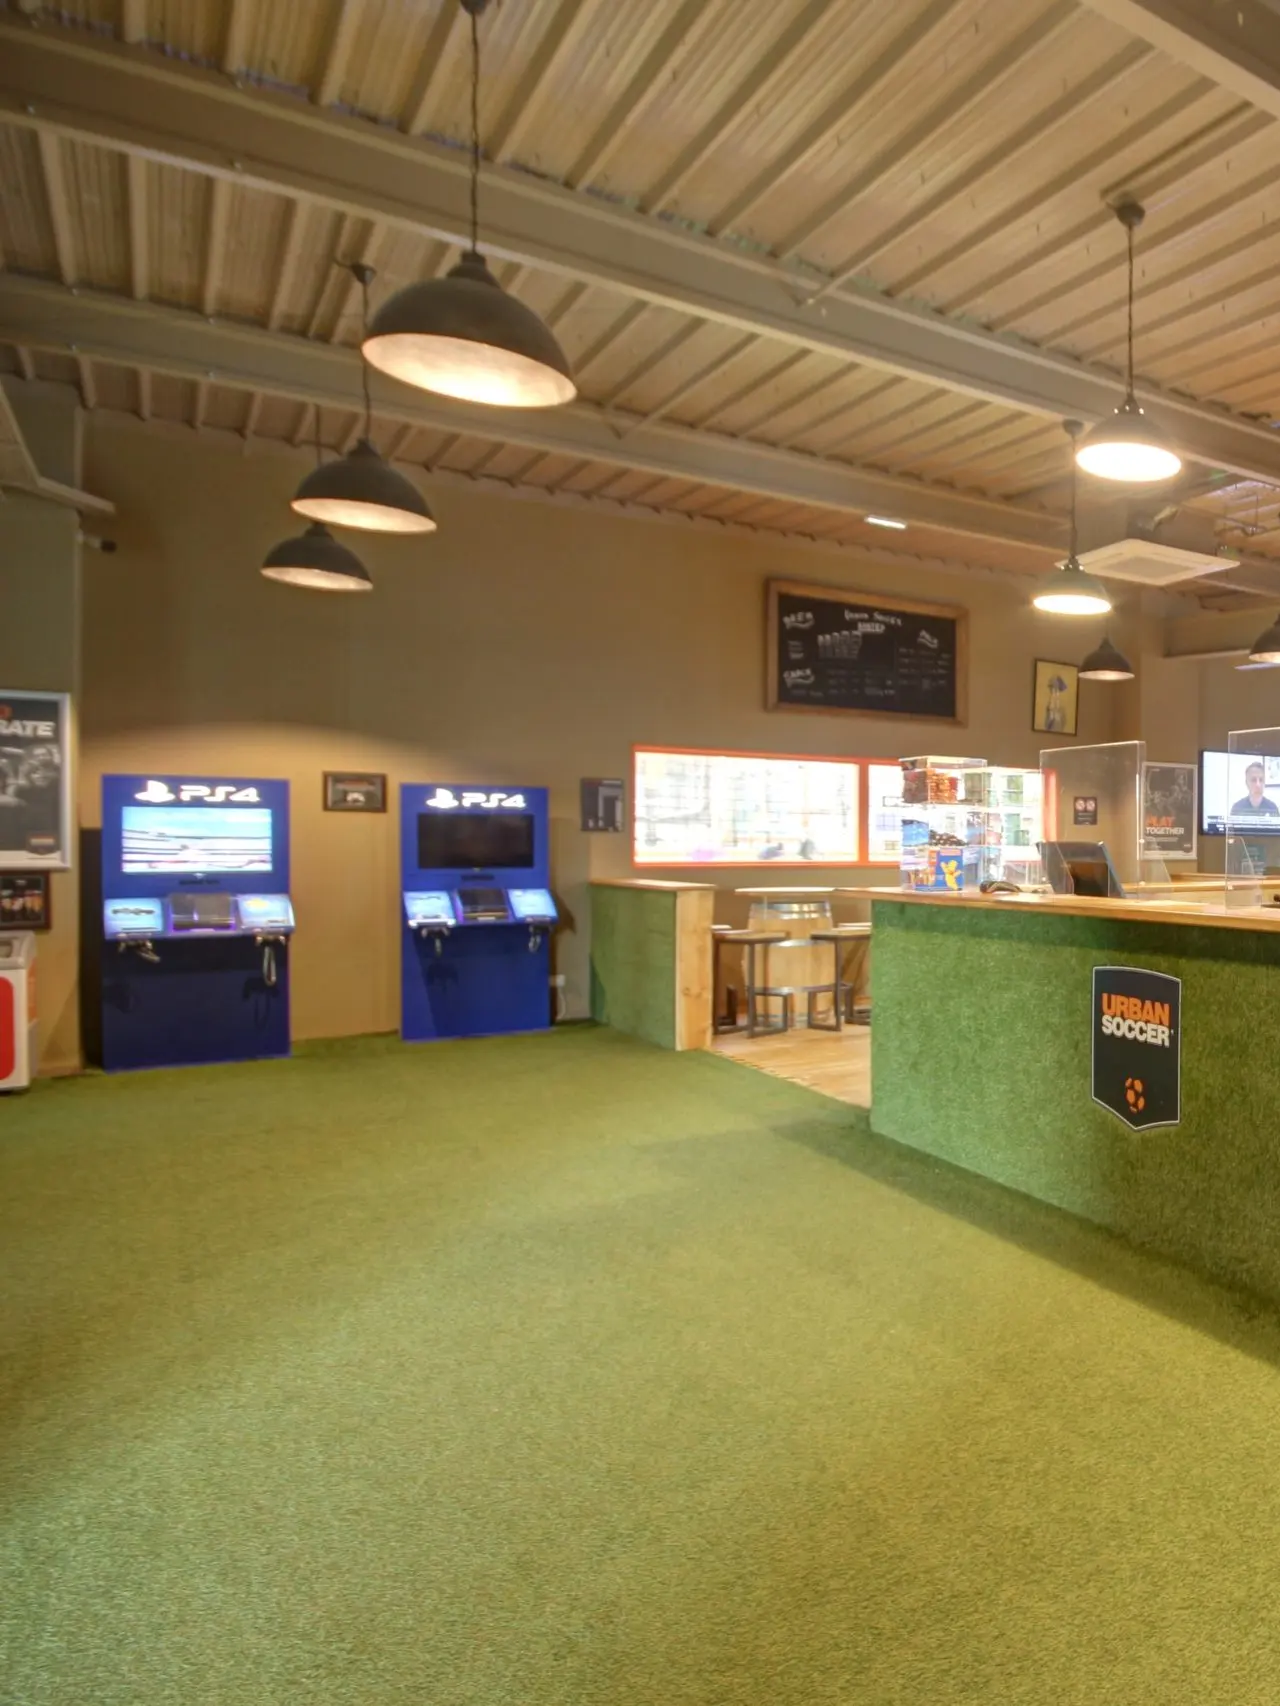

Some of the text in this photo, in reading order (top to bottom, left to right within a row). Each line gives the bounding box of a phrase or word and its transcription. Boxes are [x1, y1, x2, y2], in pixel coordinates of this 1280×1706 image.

[179, 785, 260, 802] PS4
[461, 792, 526, 808] PS4
[1145, 827, 1185, 835] TOGETHER
[1102, 993, 1170, 1026] URBAN
[1101, 1014, 1170, 1048] SOCCER
